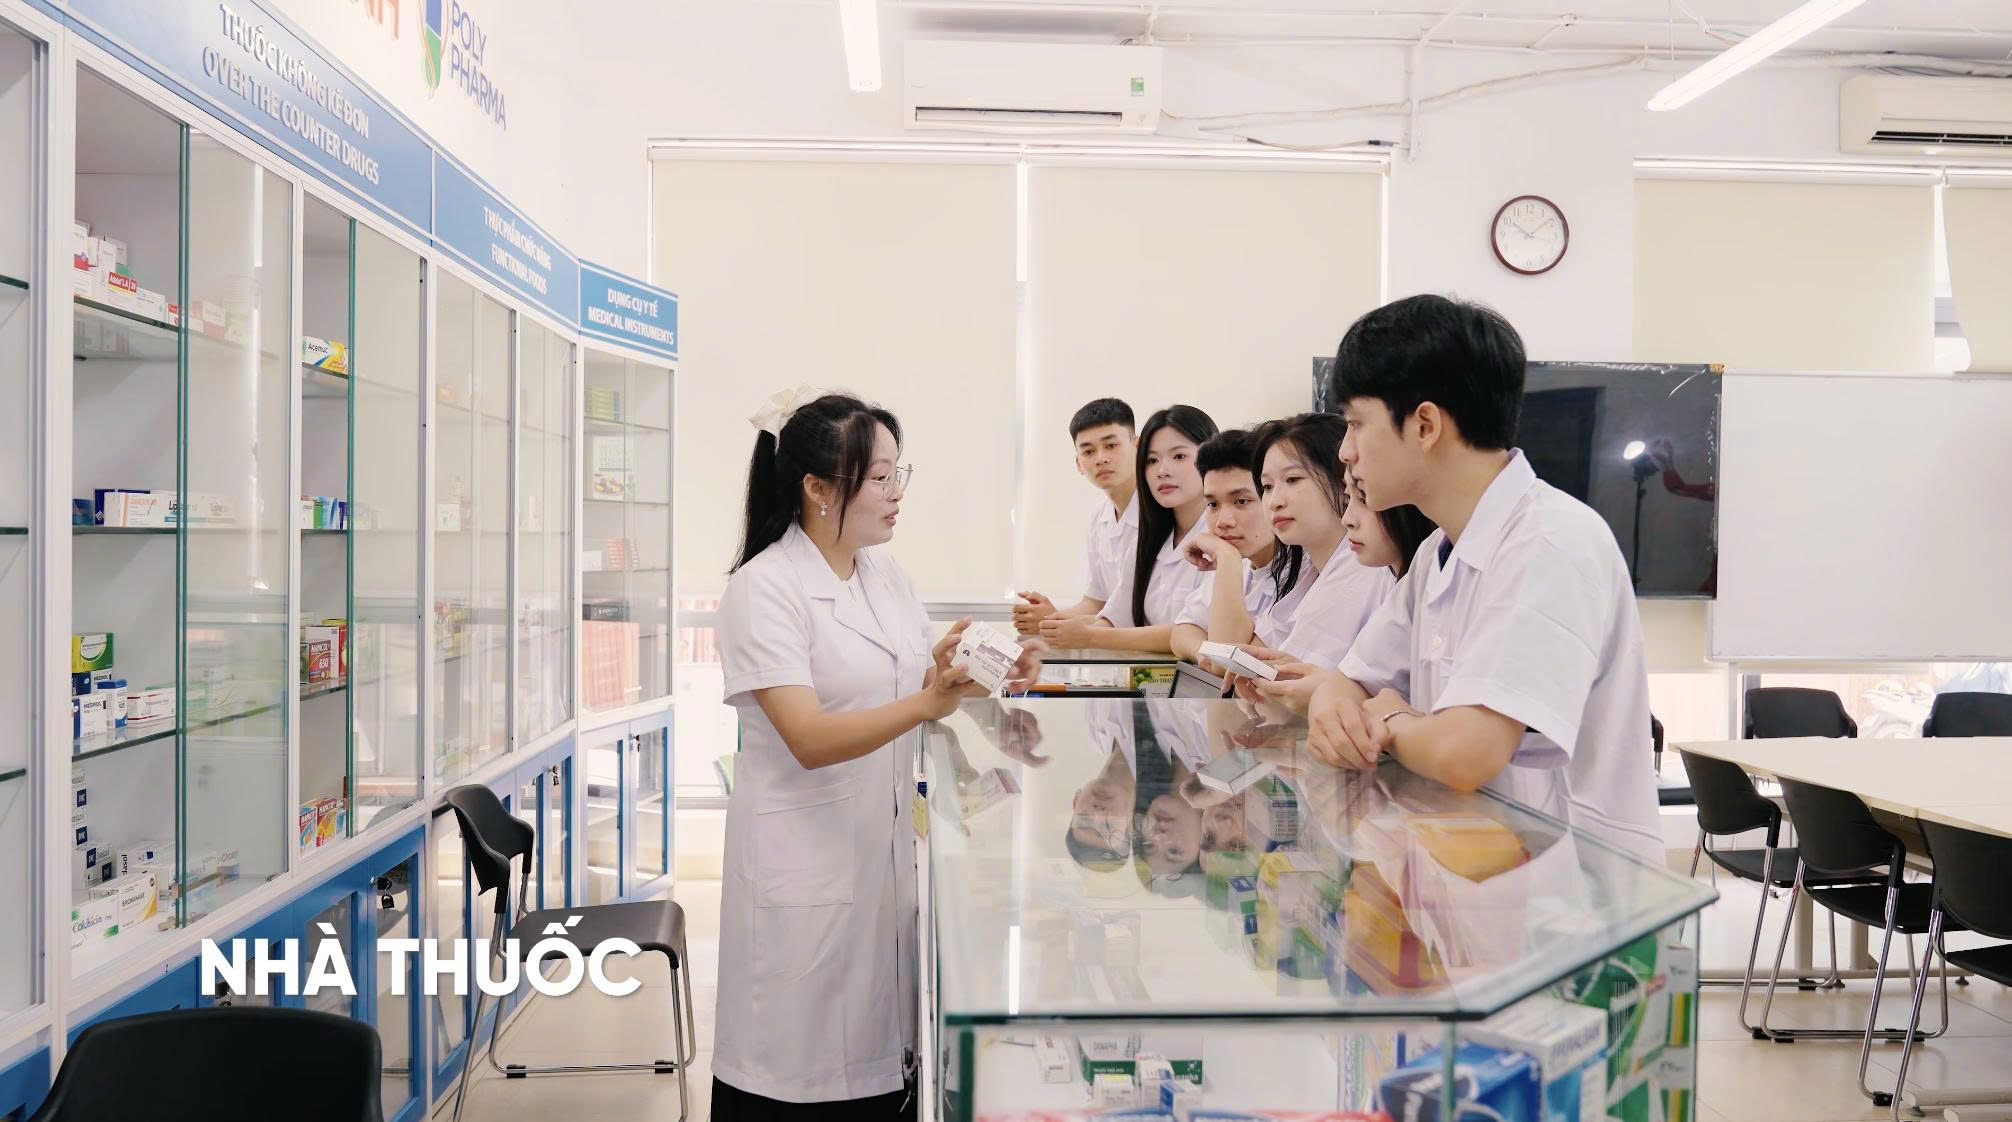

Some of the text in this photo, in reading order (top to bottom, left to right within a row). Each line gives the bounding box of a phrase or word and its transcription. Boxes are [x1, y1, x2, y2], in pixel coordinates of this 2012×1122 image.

[220, 3, 277, 72] THUỐC
[277, 48, 326, 108] KHÔNG
[451, 1, 487, 66] POLY
[202, 46, 379, 185] OVER THE COUNTER DRUGS
[451, 42, 506, 131] PHARMA
[491, 243, 547, 295] FUNCTIONAL FOODS
[588, 305, 674, 346] MEDICAL INSTRUMENTS
[607, 287, 631, 309] DỤNG
[632, 297, 643, 317] CỤ
[648, 299, 658, 318] TẾ
